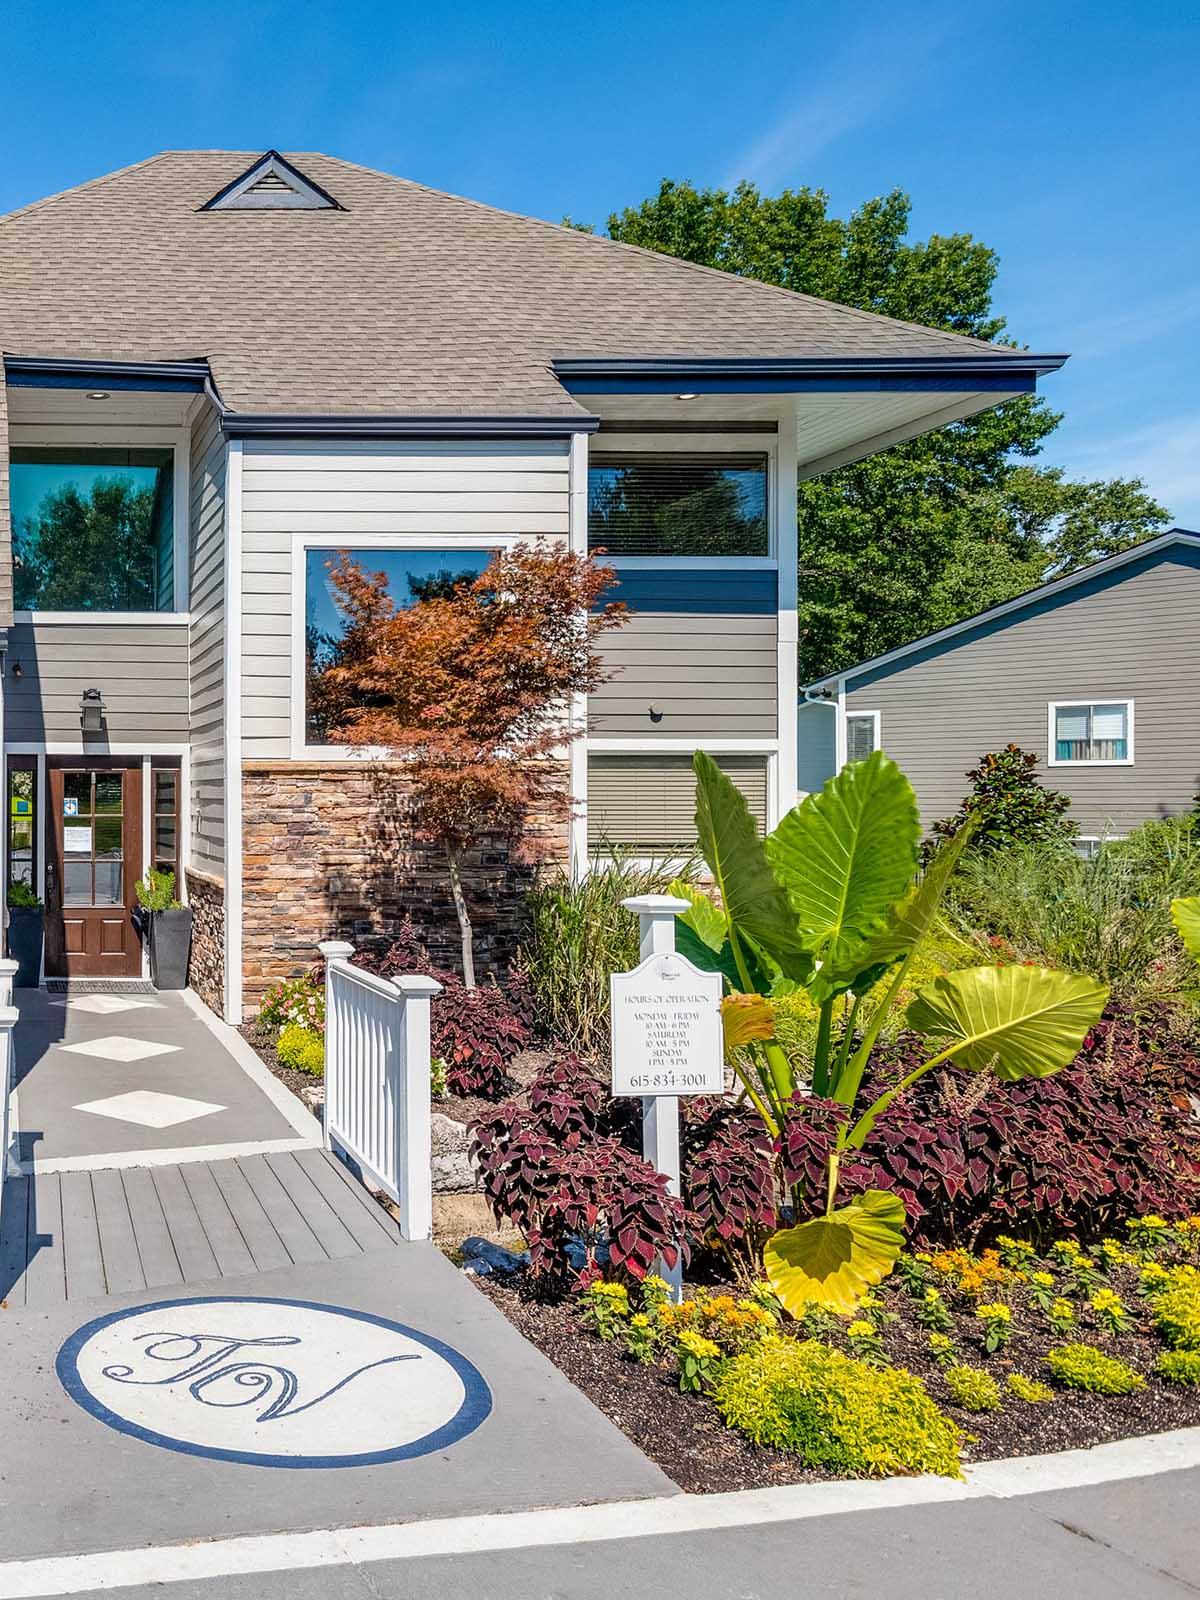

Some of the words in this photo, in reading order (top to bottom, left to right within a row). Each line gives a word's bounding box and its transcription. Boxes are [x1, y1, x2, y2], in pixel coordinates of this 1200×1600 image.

[634, 1012, 667, 1021] MONDAY
[673, 1012, 699, 1021] FRIDAY
[647, 1031, 687, 1039] SATURDAY
[630, 1073, 706, 1087] 615-834-3001
